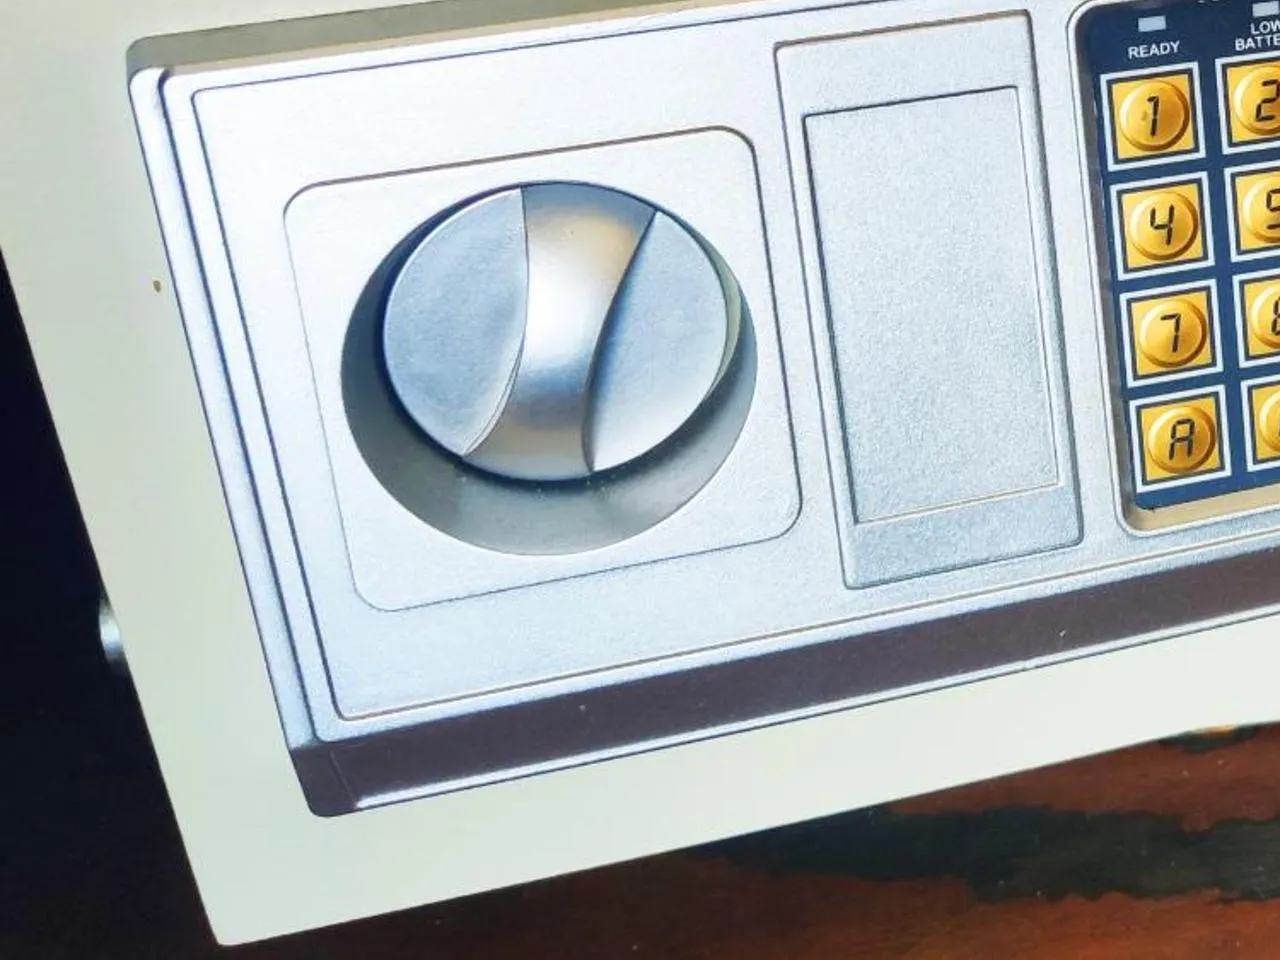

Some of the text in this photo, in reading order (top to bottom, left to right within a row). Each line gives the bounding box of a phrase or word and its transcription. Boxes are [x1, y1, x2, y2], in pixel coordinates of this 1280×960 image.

[1128, 40, 1180, 60] READY
[1146, 96, 1160, 137] 1
[1255, 79, 1280, 122] 2
[1150, 204, 1175, 245] 4
[1160, 313, 1181, 353] 7
[1169, 418, 1196, 461] A
